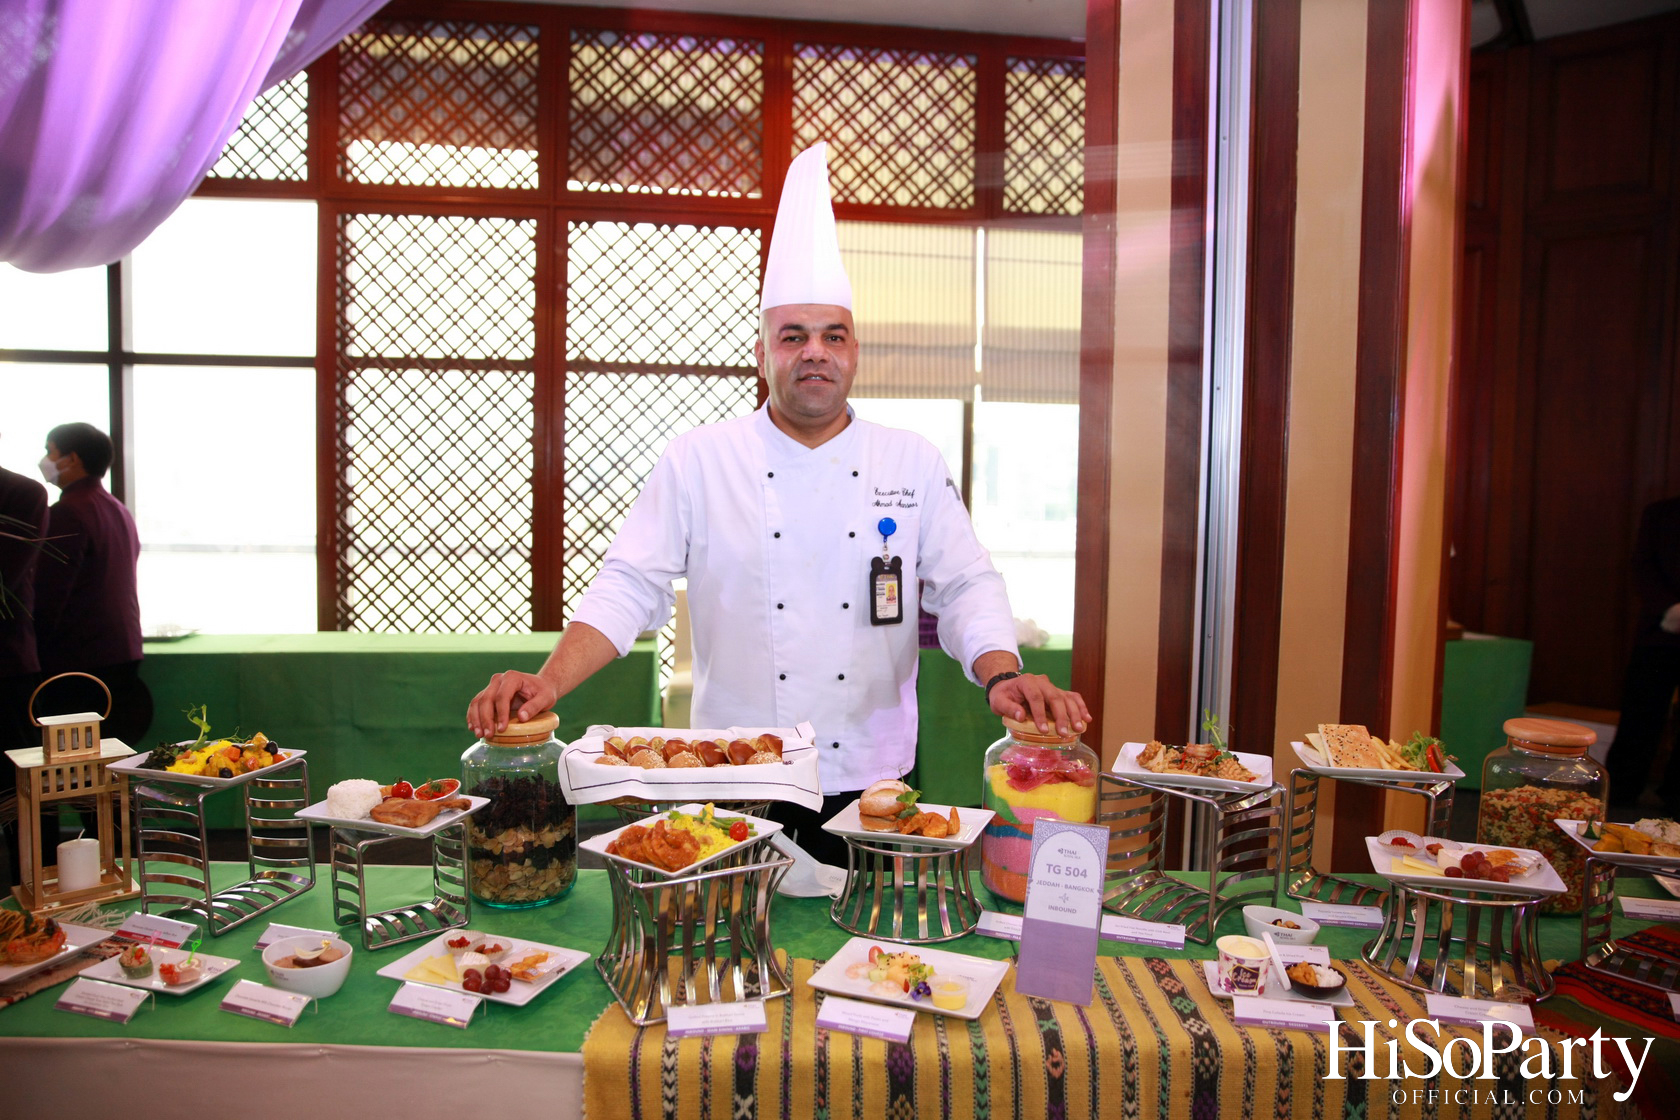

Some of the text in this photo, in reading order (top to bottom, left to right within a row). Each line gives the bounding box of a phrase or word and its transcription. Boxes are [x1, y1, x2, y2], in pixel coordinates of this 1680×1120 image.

[901, 488, 915, 499] Chef
[1046, 863, 1088, 879] TG 504
[1036, 880, 1060, 889] JEDDAH
[1064, 884, 1094, 893] BANGKOK
[1048, 904, 1077, 914] INBOUND
[1231, 971, 1257, 985] Cream
[1239, 967, 1252, 978] Ice
